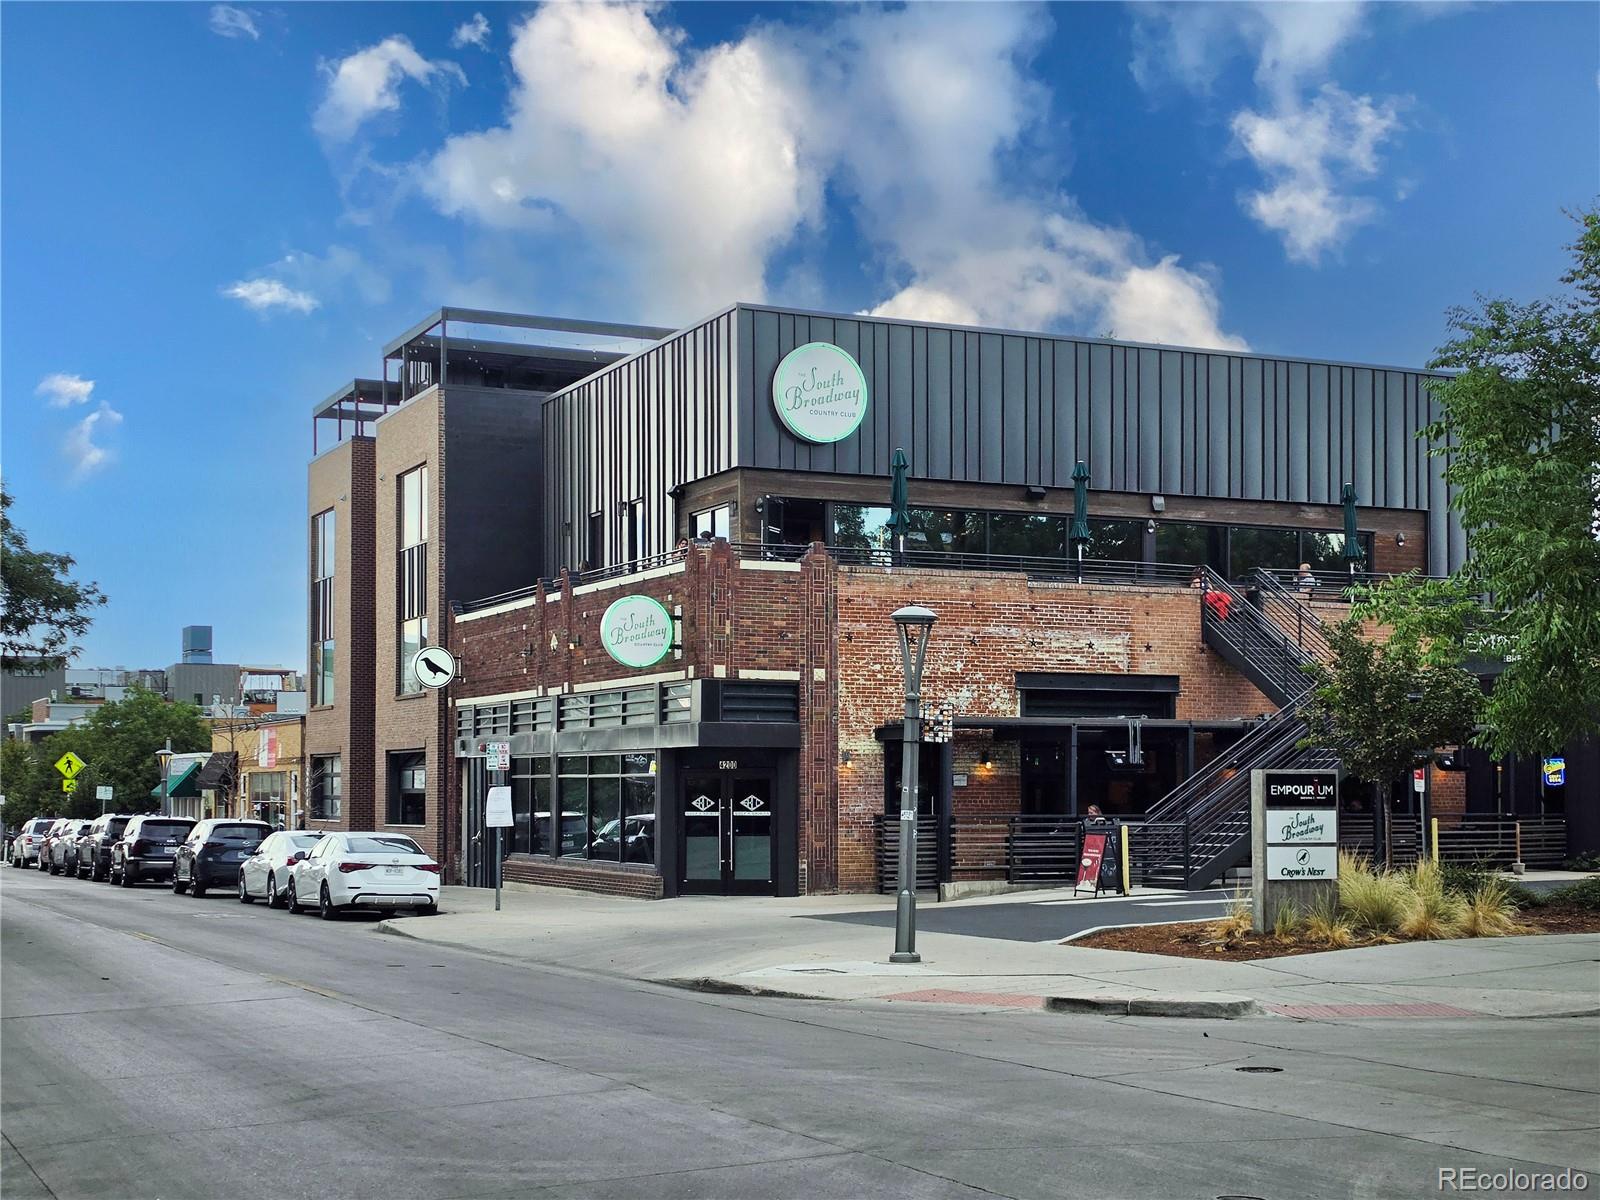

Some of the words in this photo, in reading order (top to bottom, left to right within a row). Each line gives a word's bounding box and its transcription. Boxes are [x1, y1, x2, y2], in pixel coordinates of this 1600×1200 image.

[802, 366, 844, 392] South
[785, 386, 860, 411] Broadway
[809, 409, 838, 417] COUNTRY
[623, 612, 655, 632] South
[610, 626, 667, 646] Broadway
[1291, 812, 1316, 829] South
[1281, 824, 1324, 842] Broadway
[1306, 867, 1326, 877] NEST
